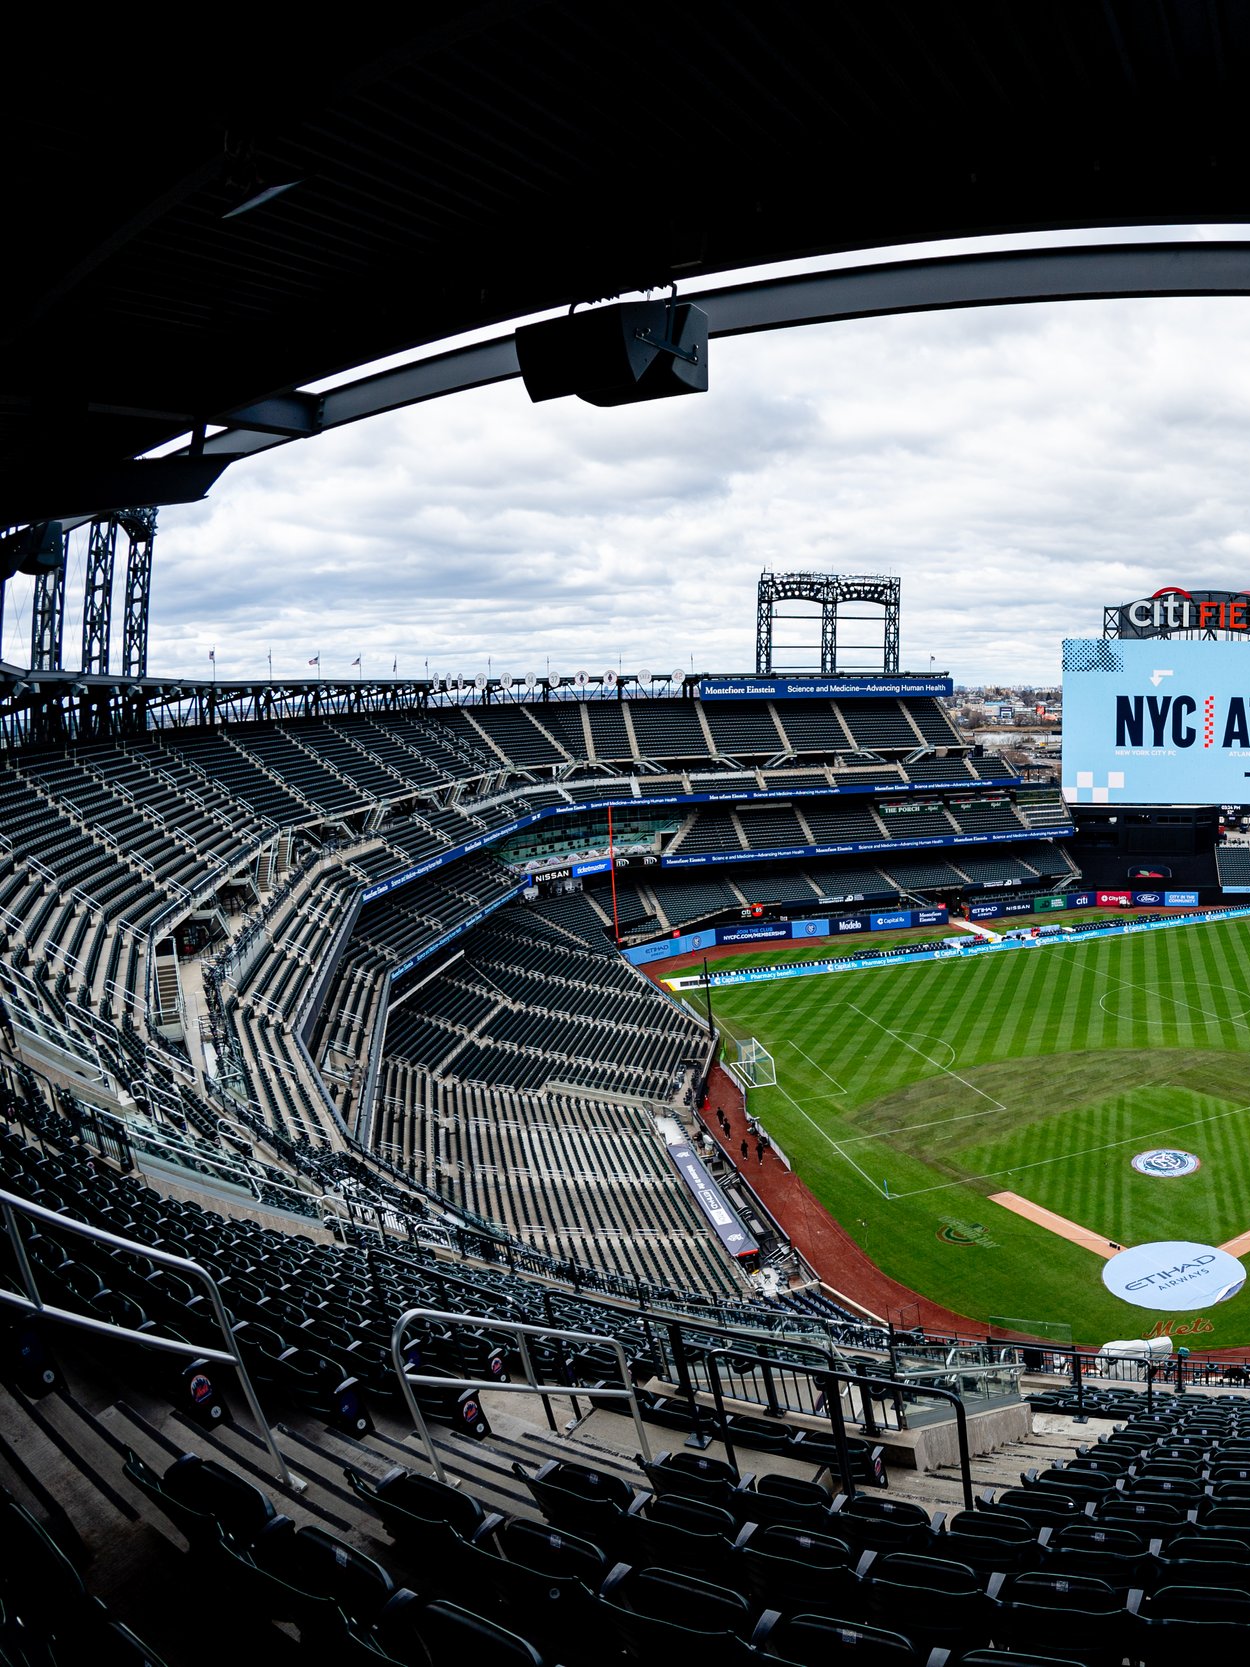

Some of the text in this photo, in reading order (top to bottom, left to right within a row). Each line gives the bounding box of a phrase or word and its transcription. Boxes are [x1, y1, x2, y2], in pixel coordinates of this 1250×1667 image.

[1129, 594, 1191, 628] citi
[705, 685, 776, 695] Montefiore Einstein
[787, 684, 814, 693] Science
[815, 684, 829, 693] and
[901, 684, 924, 692] Human
[925, 684, 946, 692] Health
[1115, 695, 1197, 749] NYC
[535, 869, 570, 882] NISSAN
[1076, 893, 1088, 905] citi
[971, 906, 998, 914] ETIHAD
[839, 920, 862, 930] Modelo
[645, 944, 669, 954] ETIHAD
[861, 958, 887, 966] Pharmacy
[750, 971, 777, 980] Pharmacy
[1125, 1254, 1216, 1291] ETIHAD
[1158, 1267, 1210, 1291] AIRWAYS
[1142, 1317, 1215, 1339] Mets
